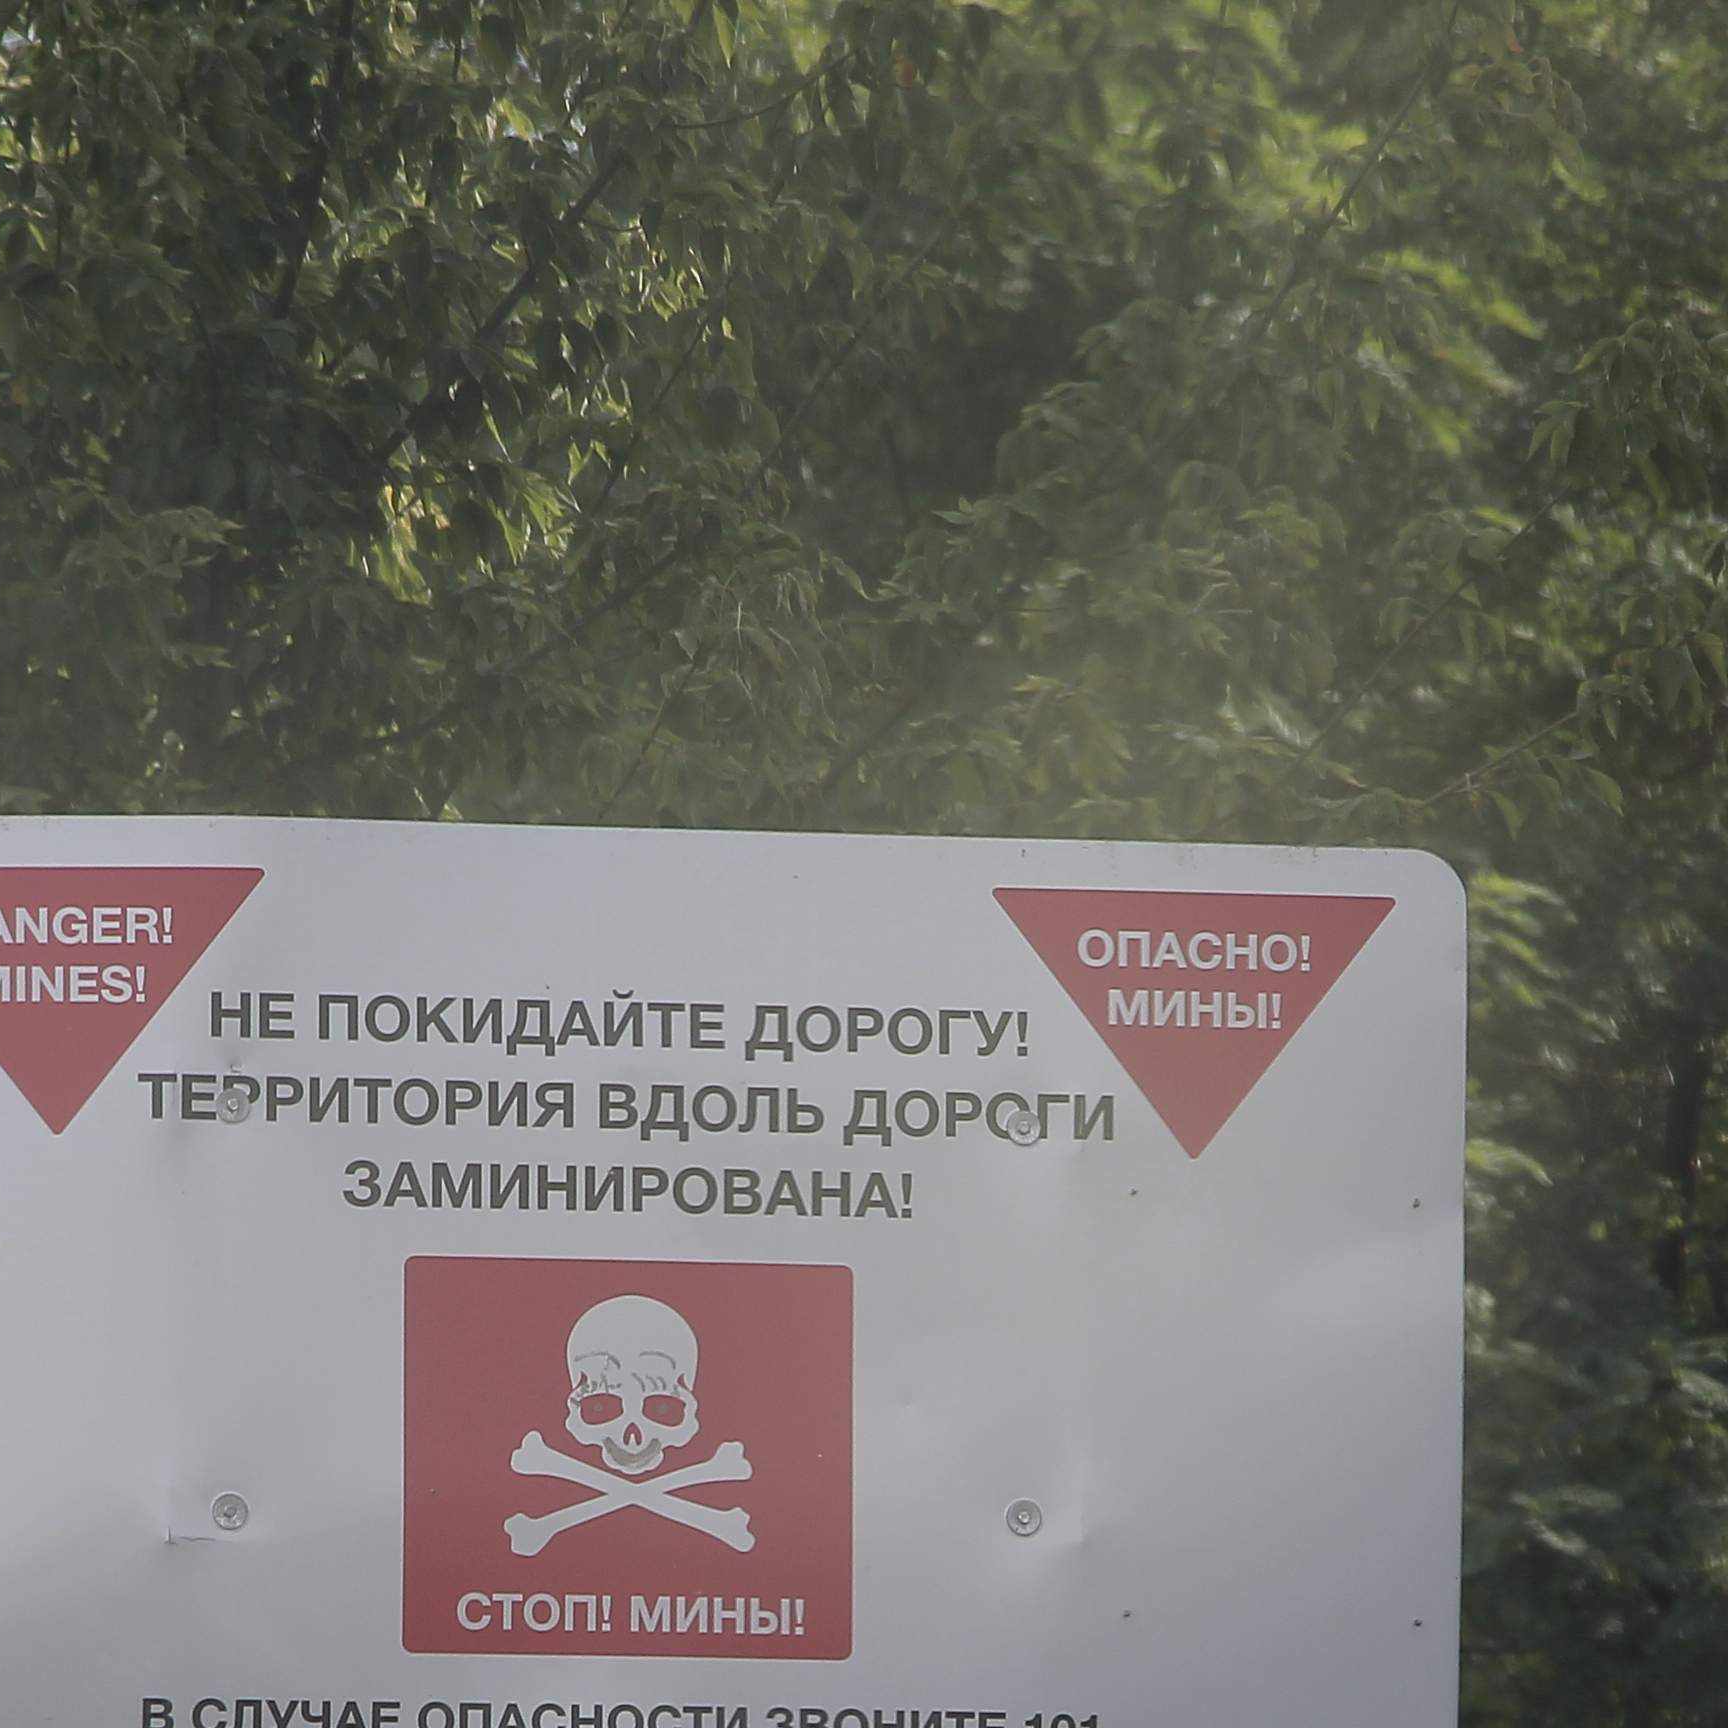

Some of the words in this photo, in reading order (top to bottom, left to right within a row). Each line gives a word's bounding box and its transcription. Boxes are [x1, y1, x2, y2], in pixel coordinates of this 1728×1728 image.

[1077, 929, 1311, 972] ОПАСНО!
[210, 991, 295, 1041] НЕ
[318, 989, 726, 1057] ПОКИДАЙТЕ
[744, 1004, 1030, 1063] ДОРОГУ!
[1107, 988, 1282, 1030] МИНЫ!
[598, 1083, 825, 1143] ВДОЛЬ
[842, 1089, 1115, 1147] ДОРОГИ
[342, 1160, 914, 1219] ЗАМИНИРОВАНА!
[456, 1592, 612, 1632] СТОП!
[630, 1595, 806, 1637] МИНЫ!
